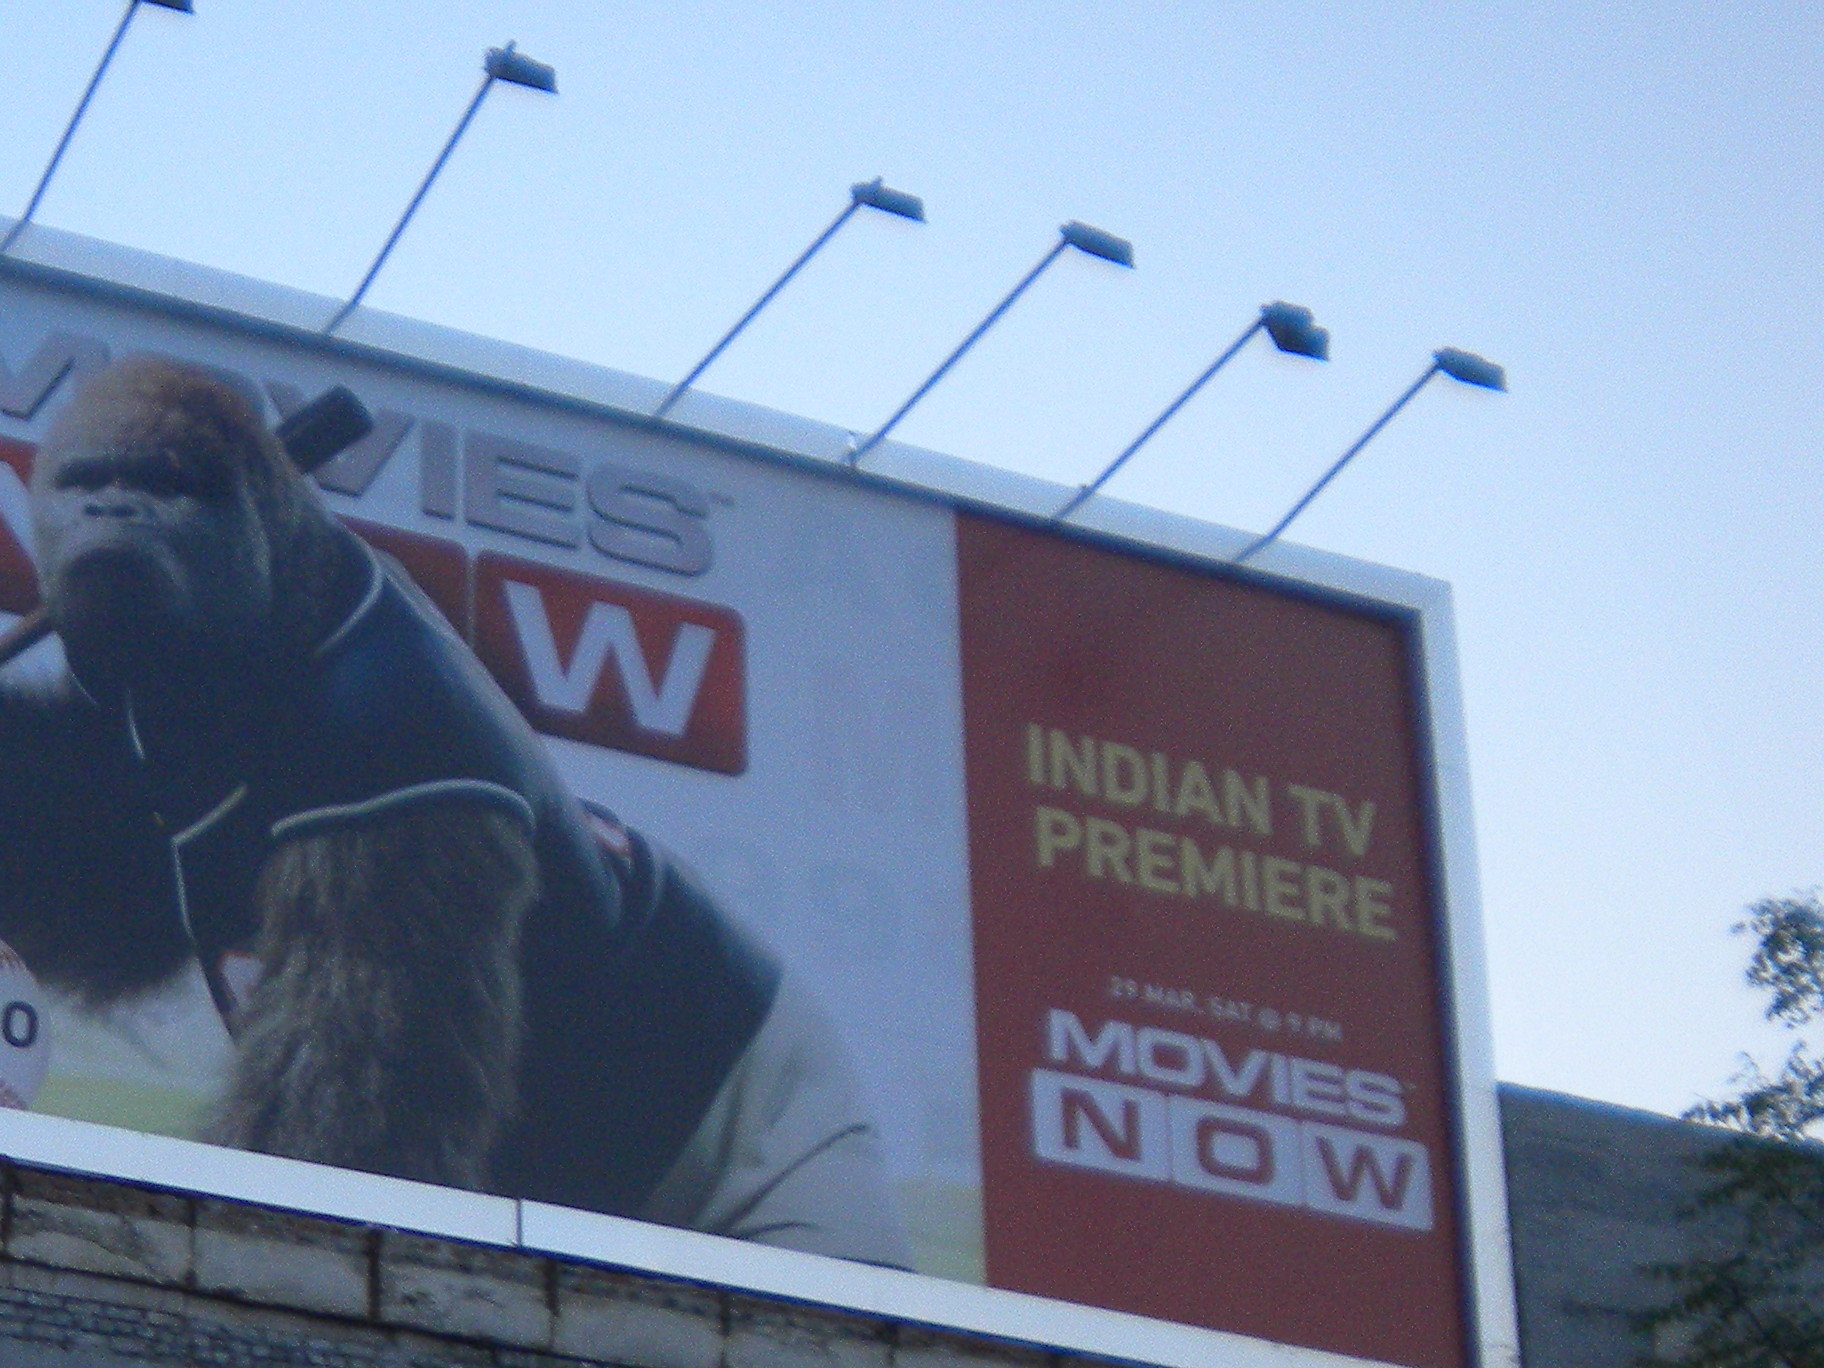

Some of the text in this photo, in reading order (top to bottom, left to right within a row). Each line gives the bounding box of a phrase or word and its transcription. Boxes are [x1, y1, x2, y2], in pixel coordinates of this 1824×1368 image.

[1028, 722, 1375, 855] INDIAN TV
[1035, 805, 1398, 941] PREMIERE
[1048, 1008, 1406, 1127] MOVIES
[1208, 996, 1251, 1021] SAT
[1307, 1016, 1342, 1041] PM
[1062, 1087, 1415, 1212] NOW
